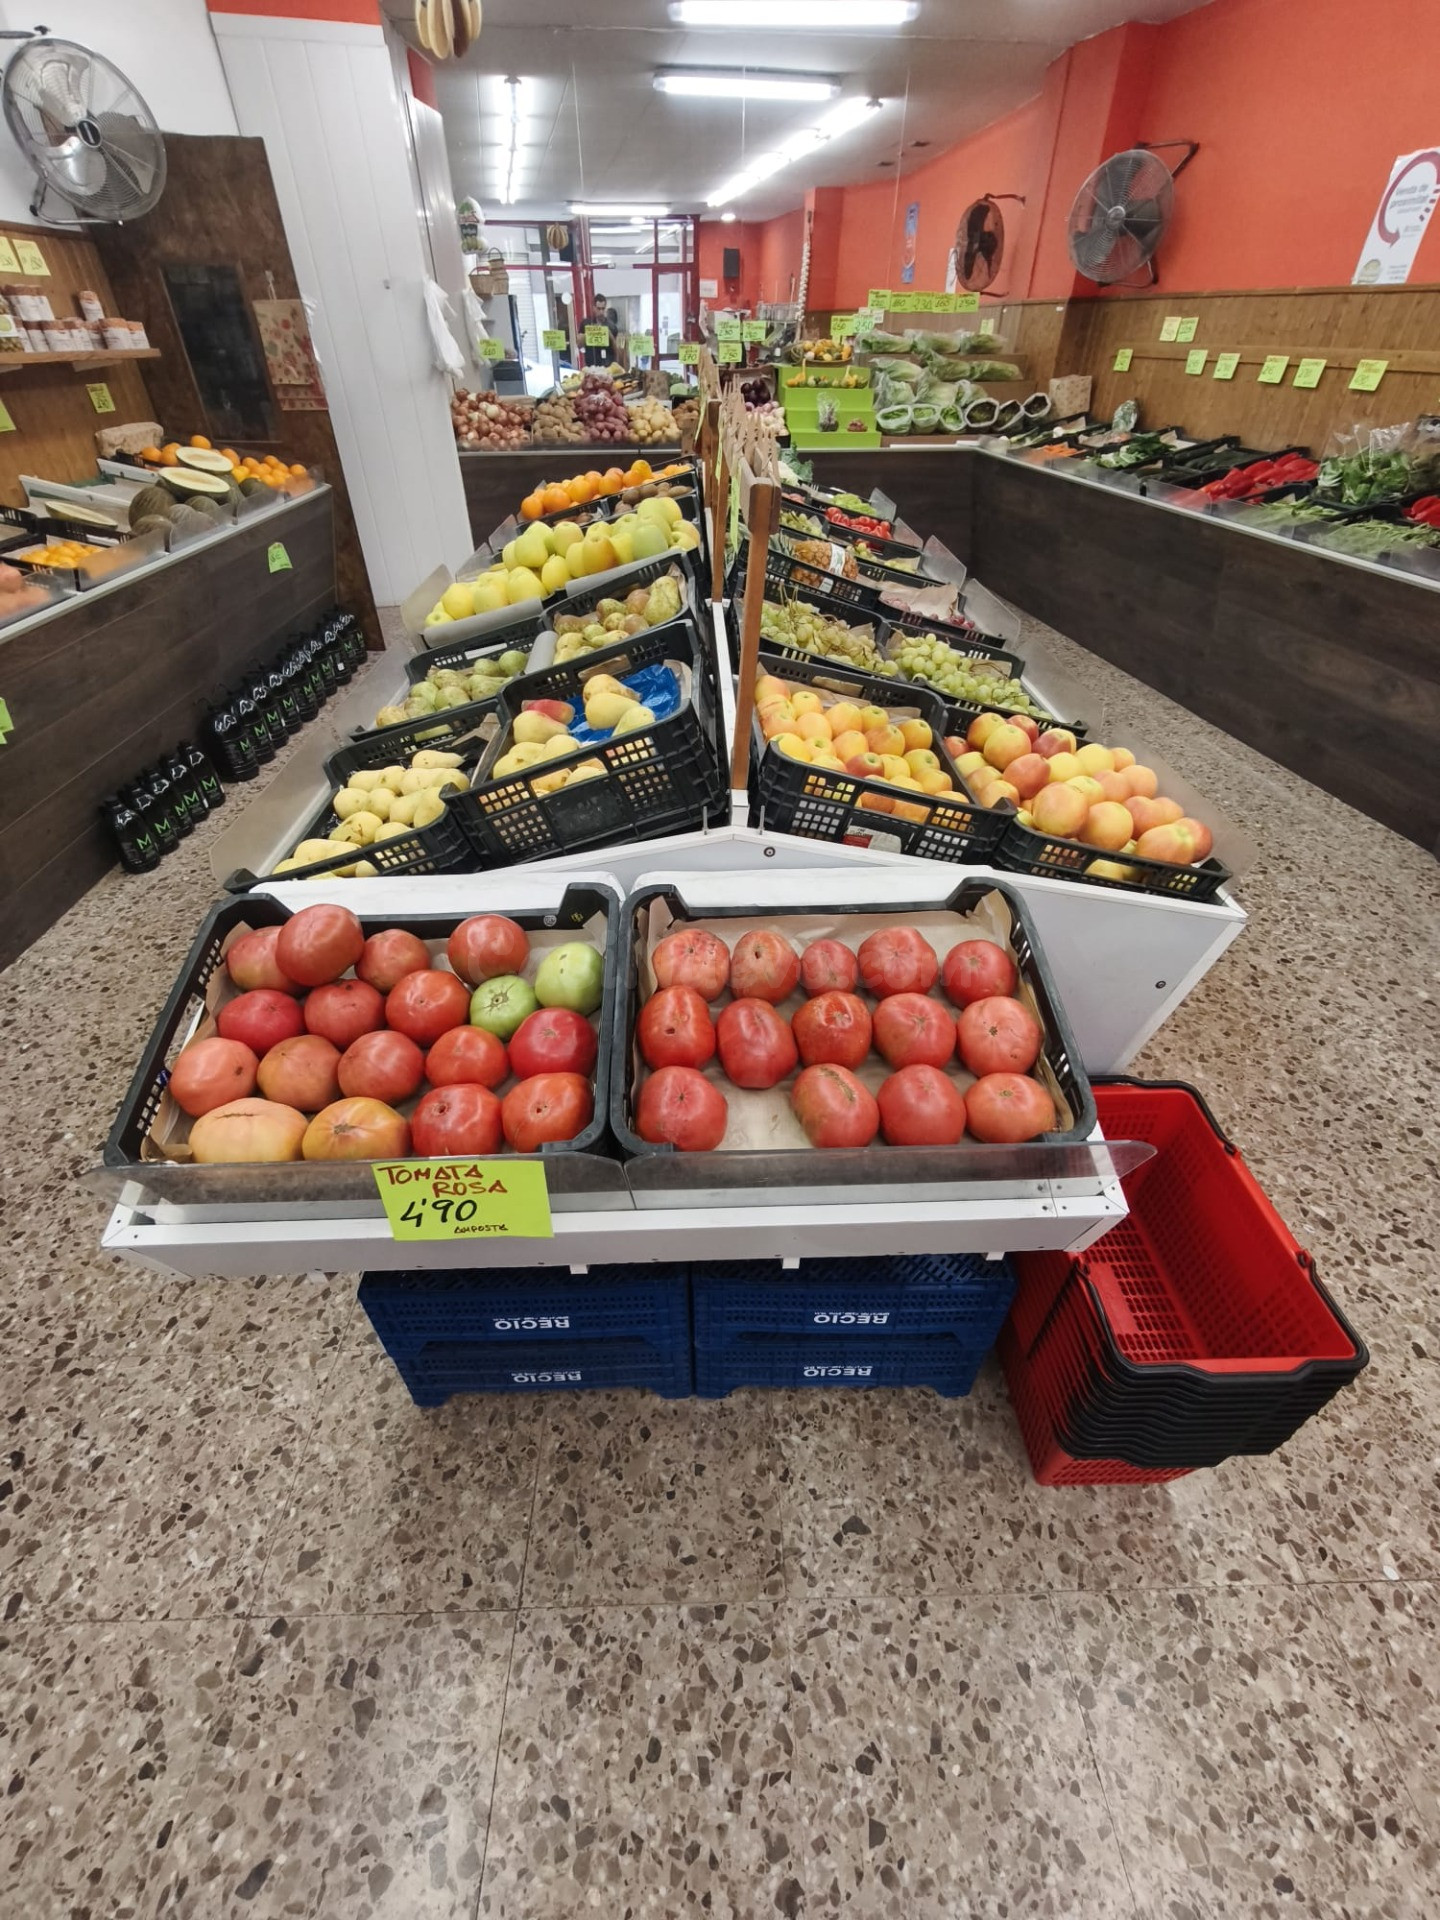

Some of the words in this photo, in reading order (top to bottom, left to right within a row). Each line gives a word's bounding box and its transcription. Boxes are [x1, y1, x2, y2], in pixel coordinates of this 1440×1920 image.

[282, 697, 294, 709] M
[266, 711, 279, 723] M
[254, 724, 267, 737] M
[201, 776, 217, 791] M
[183, 791, 200, 805] M
[174, 801, 188, 816] M
[154, 818, 171, 834] M
[136, 833, 152, 850] M
[377, 1164, 484, 1185] TOMATA
[432, 1180, 508, 1198] ROSA
[400, 1198, 478, 1228] 4'90
[494, 1319, 570, 1330] RECIO
[813, 1314, 888, 1324] RECIO
[513, 1373, 582, 1383] RECIO
[803, 1368, 872, 1378] RECIO
